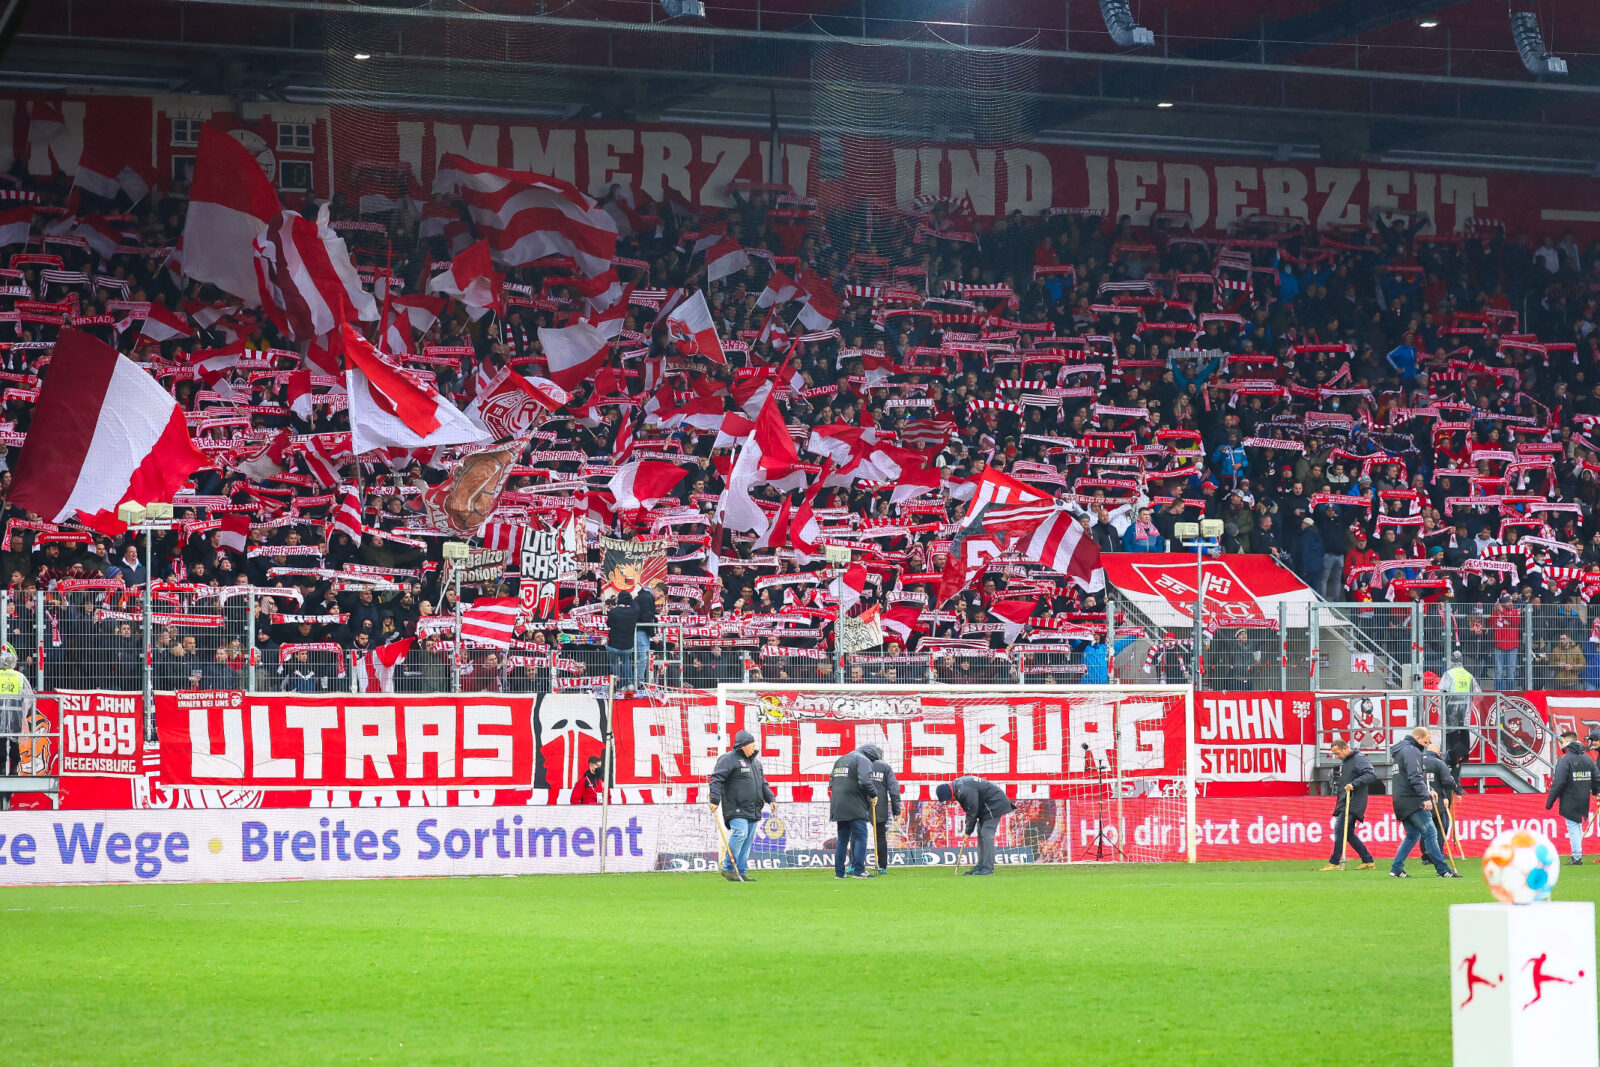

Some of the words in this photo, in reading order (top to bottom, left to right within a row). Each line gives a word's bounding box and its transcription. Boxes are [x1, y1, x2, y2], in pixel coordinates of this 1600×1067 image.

[397, 121, 812, 210] IMMERZU
[893, 148, 1052, 217] UND
[1084, 155, 1489, 236] JEDERZEIT
[886, 399, 905, 407] SSV
[63, 696, 89, 711] SSV
[96, 698, 136, 714] JAHN
[178, 692, 214, 701] CHRISTOPH
[216, 692, 229, 700] FÜR
[178, 700, 201, 708] IMMER
[216, 700, 229, 708] UNS
[63, 715, 136, 755] 1889
[632, 699, 1166, 779] REGENSBURG
[1201, 698, 1285, 741] JAHN
[190, 704, 514, 779] ULTRAS
[1201, 748, 1287, 774] STADION
[64, 757, 137, 773] REGENSBURG
[53, 821, 190, 878] Wege
[241, 816, 402, 863] Breites
[416, 814, 643, 859] Sortiment
[1080, 818, 1126, 847] Hol
[1134, 816, 1172, 846] dir
[1177, 818, 1240, 854] jetzt
[1247, 815, 1323, 845] deine
[1511, 817, 1558, 841] von
